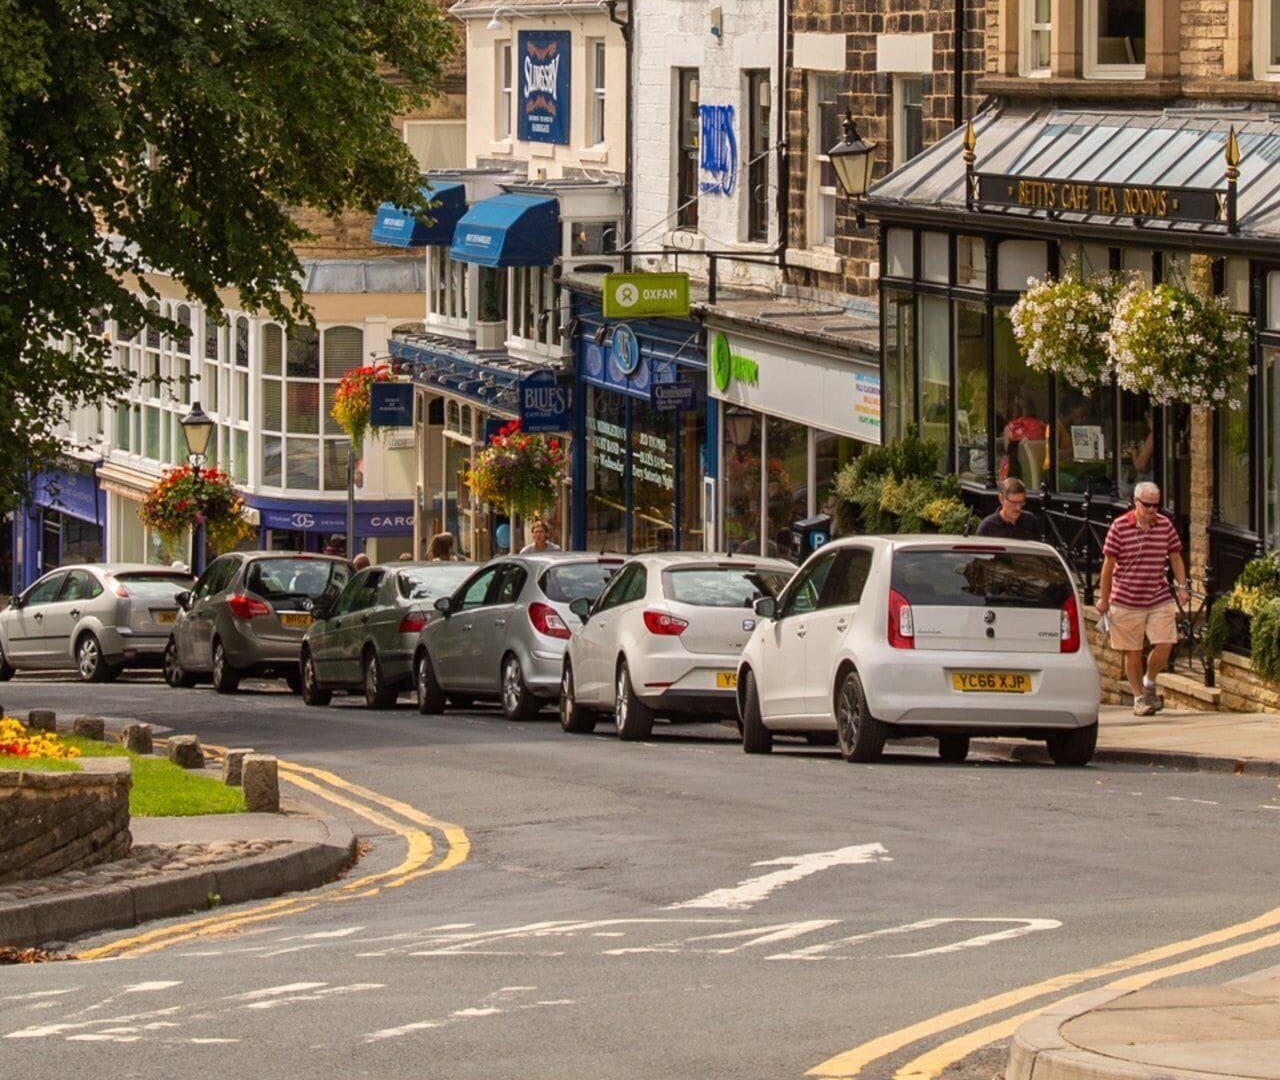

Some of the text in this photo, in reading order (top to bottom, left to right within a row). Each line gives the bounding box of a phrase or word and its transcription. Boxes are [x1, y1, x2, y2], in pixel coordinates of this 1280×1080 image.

[1018, 180, 1167, 217] BETTYS CAFE TEA ROOMS
[642, 288, 678, 300] OXFAM
[524, 387, 566, 415] BLUES
[958, 674, 1026, 690] YC66 XJP
